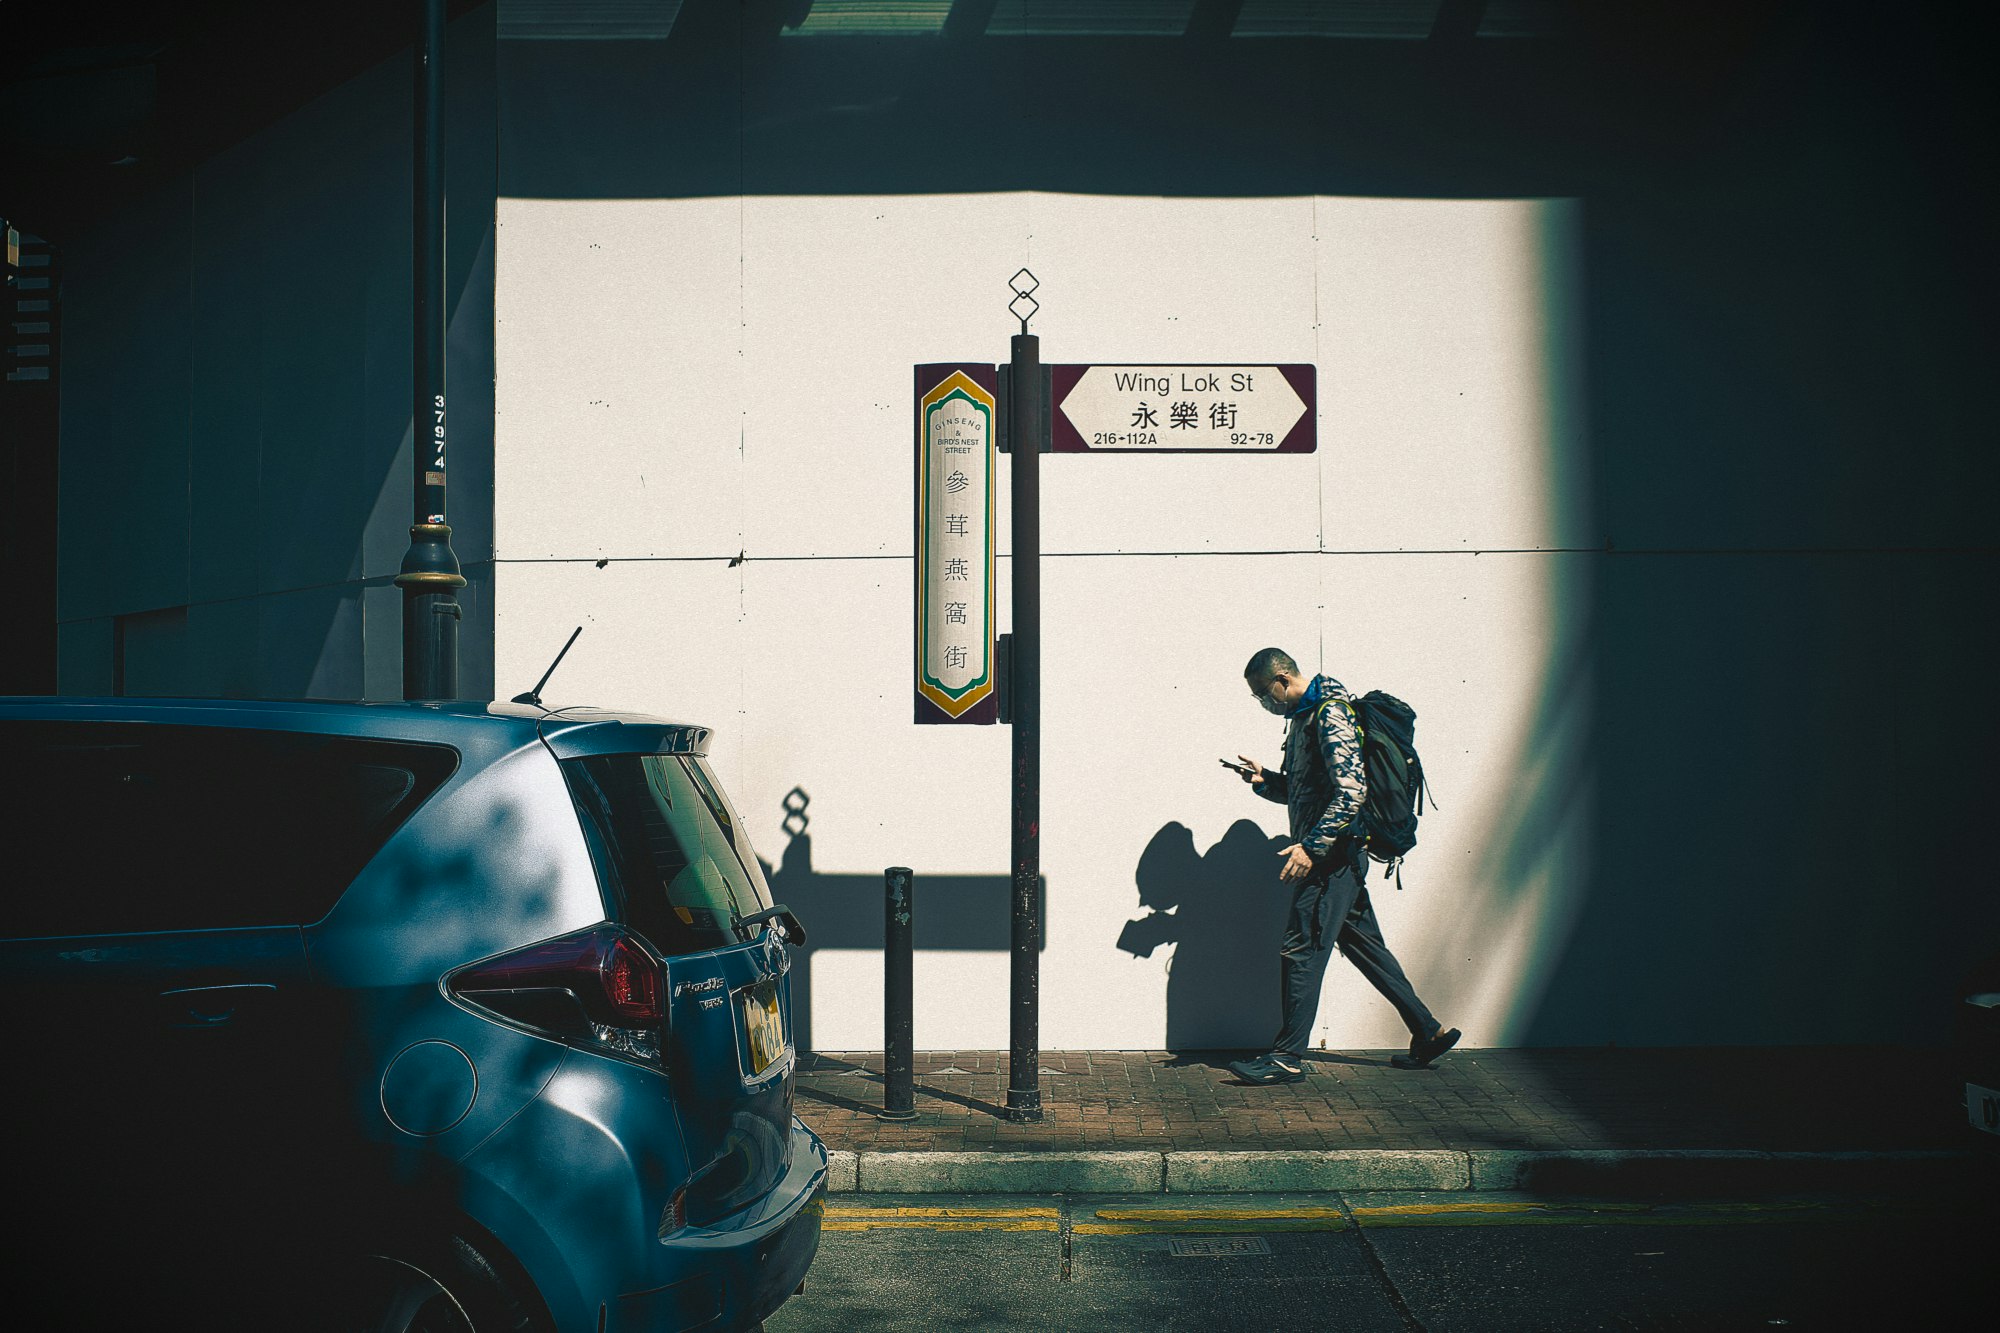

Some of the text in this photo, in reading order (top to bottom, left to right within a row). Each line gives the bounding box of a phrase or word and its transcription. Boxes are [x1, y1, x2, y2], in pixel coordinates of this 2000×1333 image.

[1114, 372, 1254, 397] Wing Lok St
[934, 417, 982, 431] GINSENG
[1130, 401, 1238, 431] 永樂街
[434, 395, 445, 469] 37974
[937, 438, 979, 446] BIRD'S NEST
[944, 446, 971, 454] STREET
[943, 470, 970, 670] 參茸燕窩街
